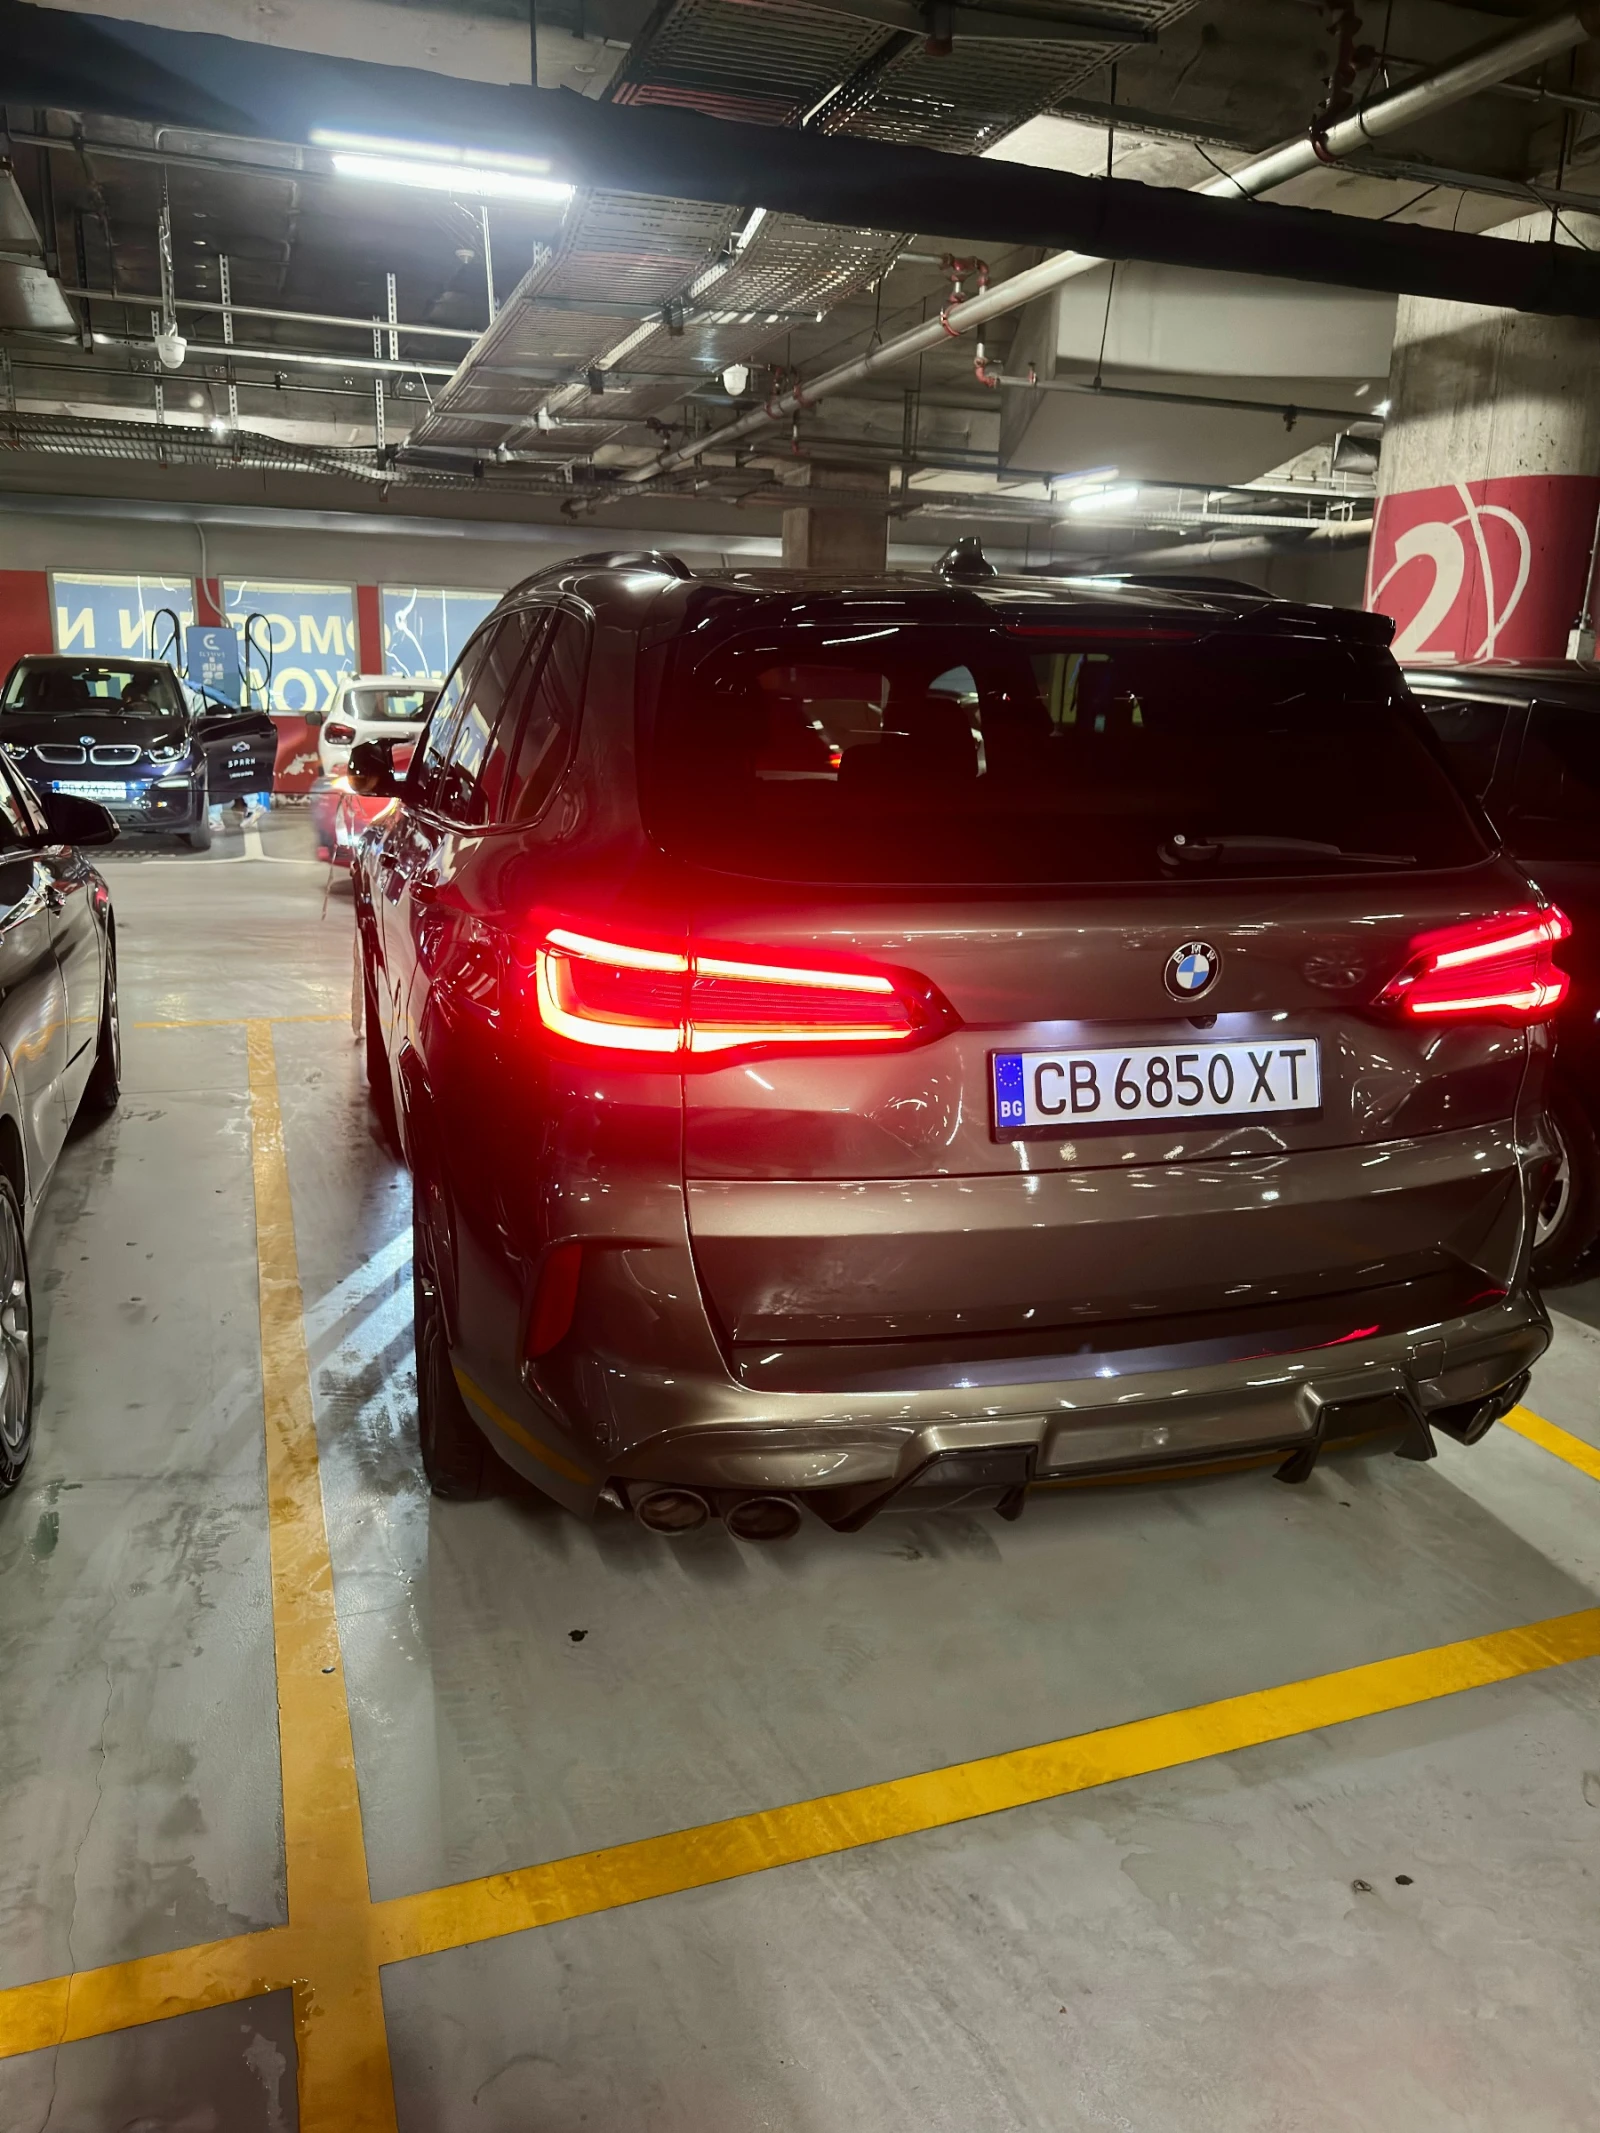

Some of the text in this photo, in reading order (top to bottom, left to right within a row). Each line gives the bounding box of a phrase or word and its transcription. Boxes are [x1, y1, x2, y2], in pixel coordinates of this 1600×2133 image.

[1172, 943, 1216, 964] BMW
[1034, 1049, 1307, 1115] CB 6850 XT
[1001, 1100, 1023, 1118] BG
